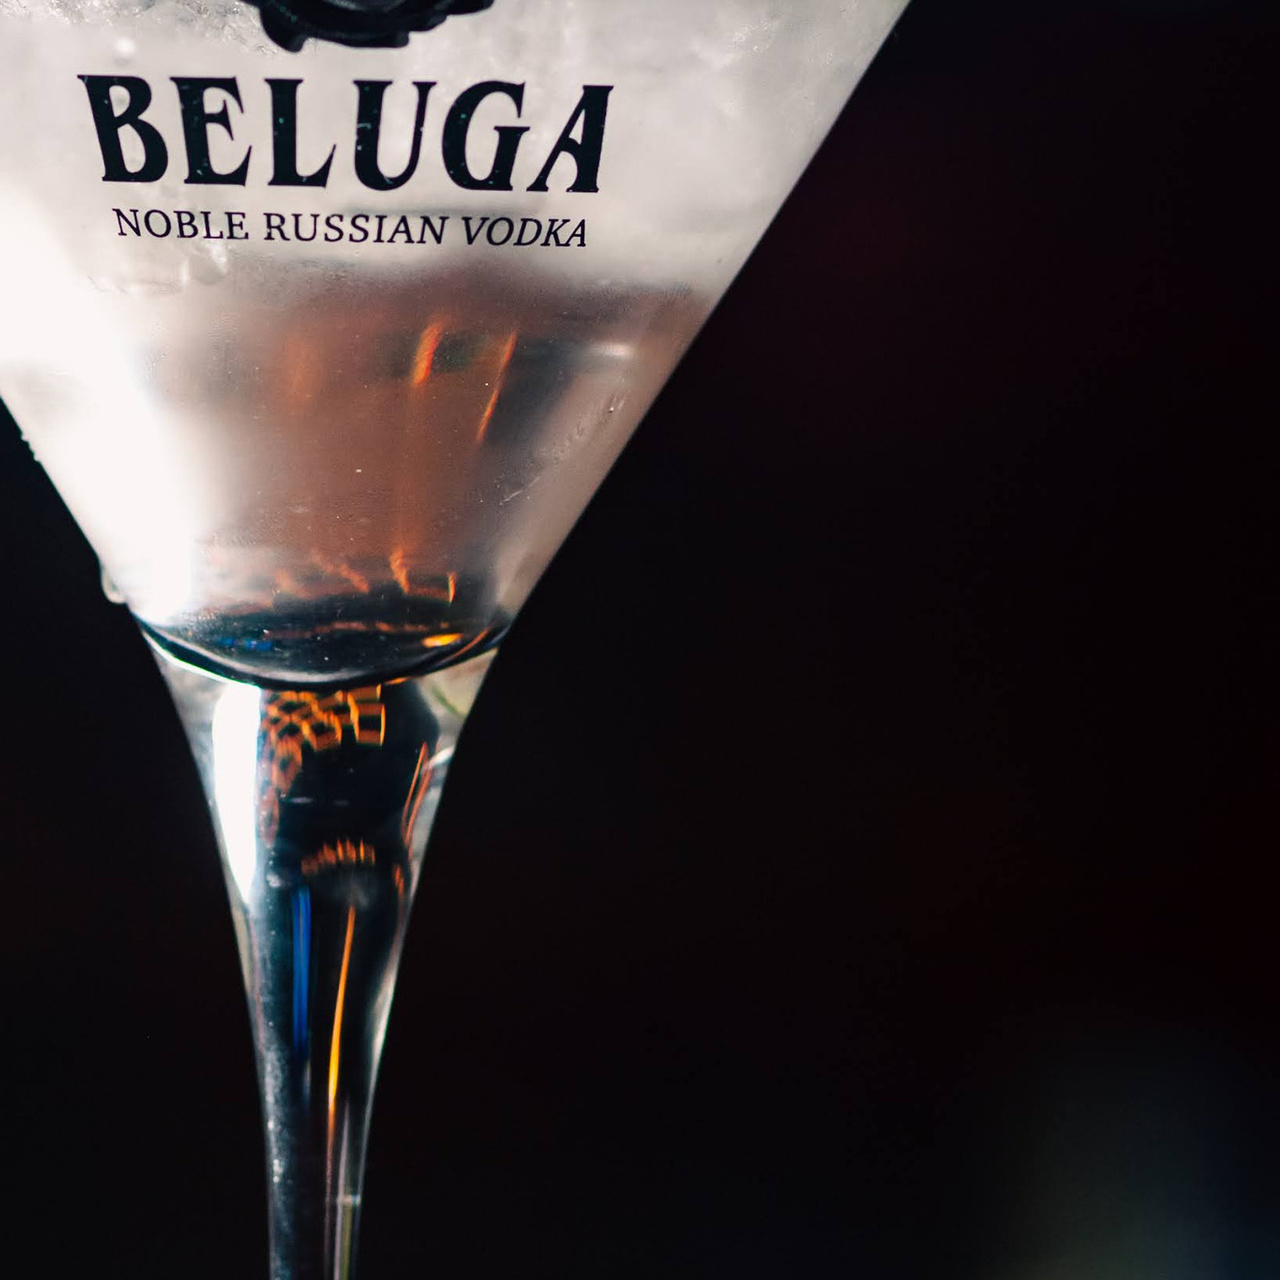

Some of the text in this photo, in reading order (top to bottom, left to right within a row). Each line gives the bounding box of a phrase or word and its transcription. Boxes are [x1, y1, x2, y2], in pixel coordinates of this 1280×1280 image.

[77, 74, 614, 193] BELUGA
[112, 207, 588, 248] NOBLE RUSSIAN VODKA
